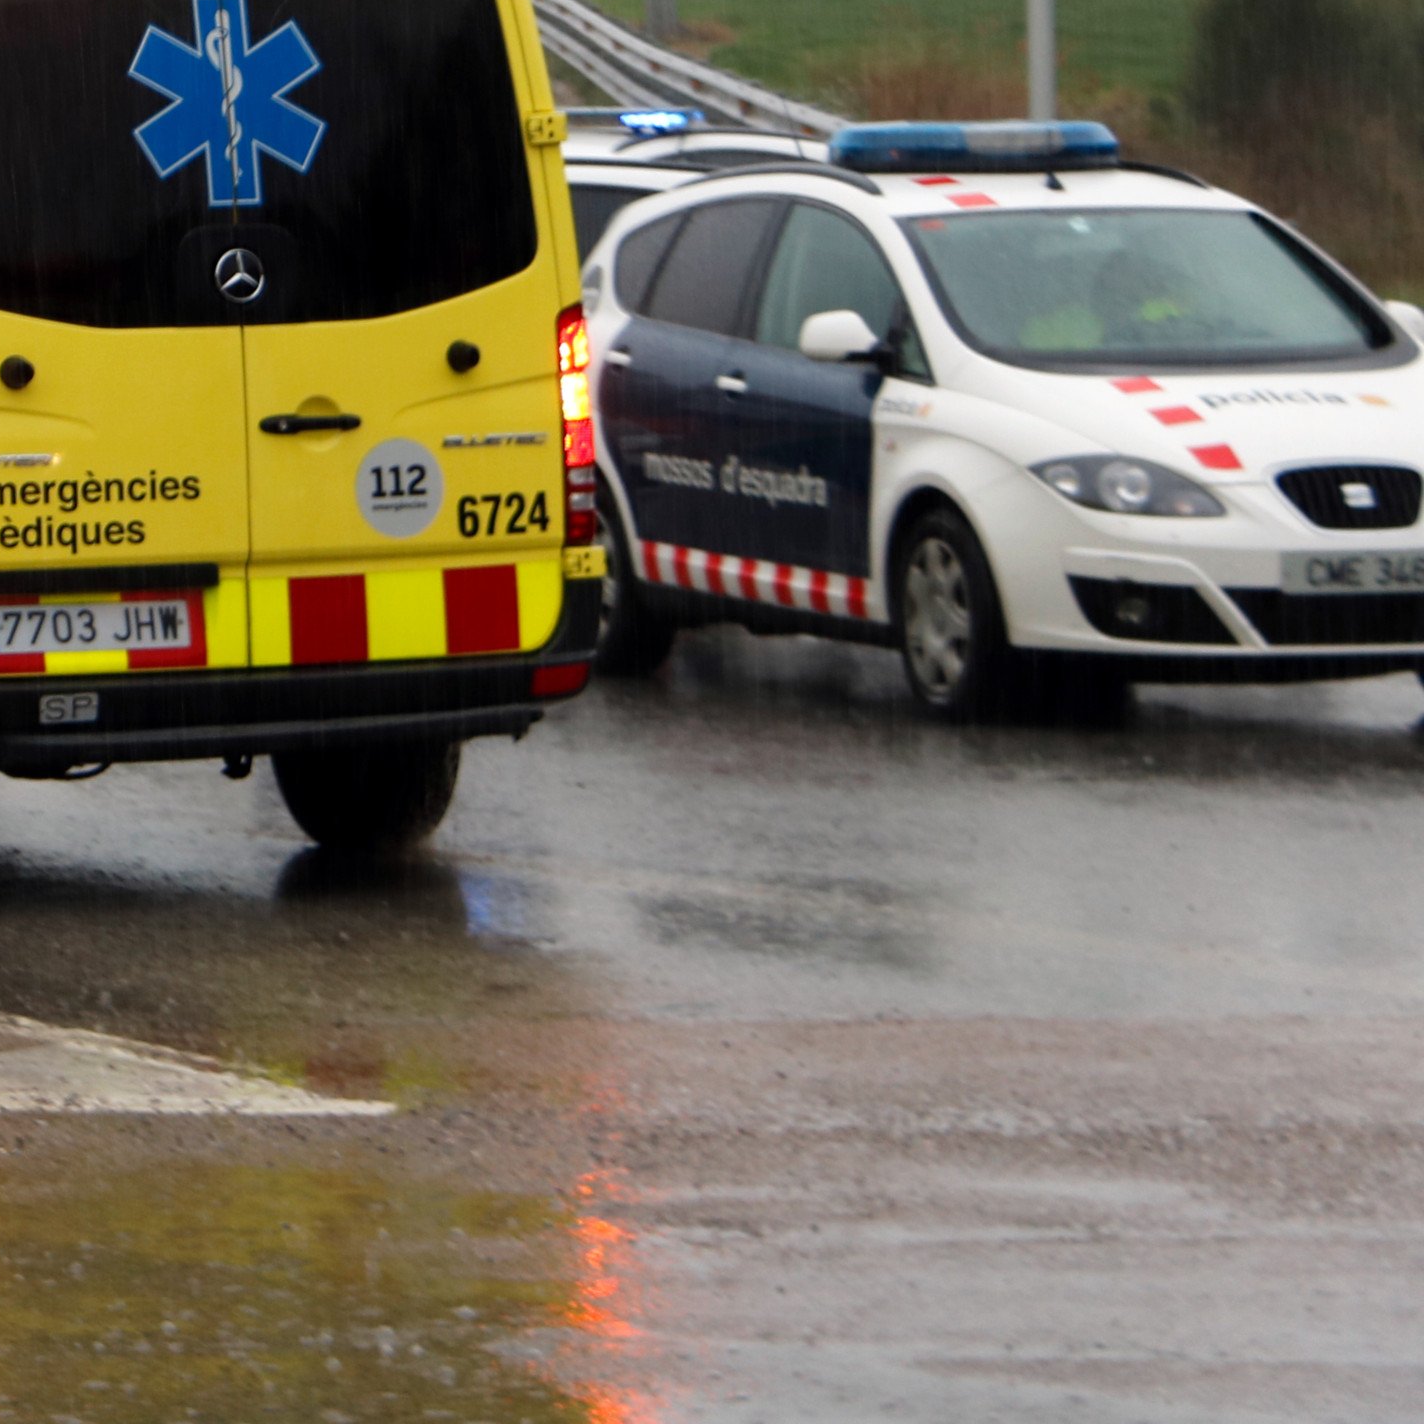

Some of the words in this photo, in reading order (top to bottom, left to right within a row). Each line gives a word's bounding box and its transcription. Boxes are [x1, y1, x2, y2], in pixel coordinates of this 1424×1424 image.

[370, 463, 428, 498] 112
[642, 451, 714, 490] mossos
[719, 455, 829, 508] d'esquadra
[457, 490, 551, 539] 6724
[2, 609, 97, 646] 7703
[113, 605, 179, 643] JHW
[44, 695, 94, 722] SP
